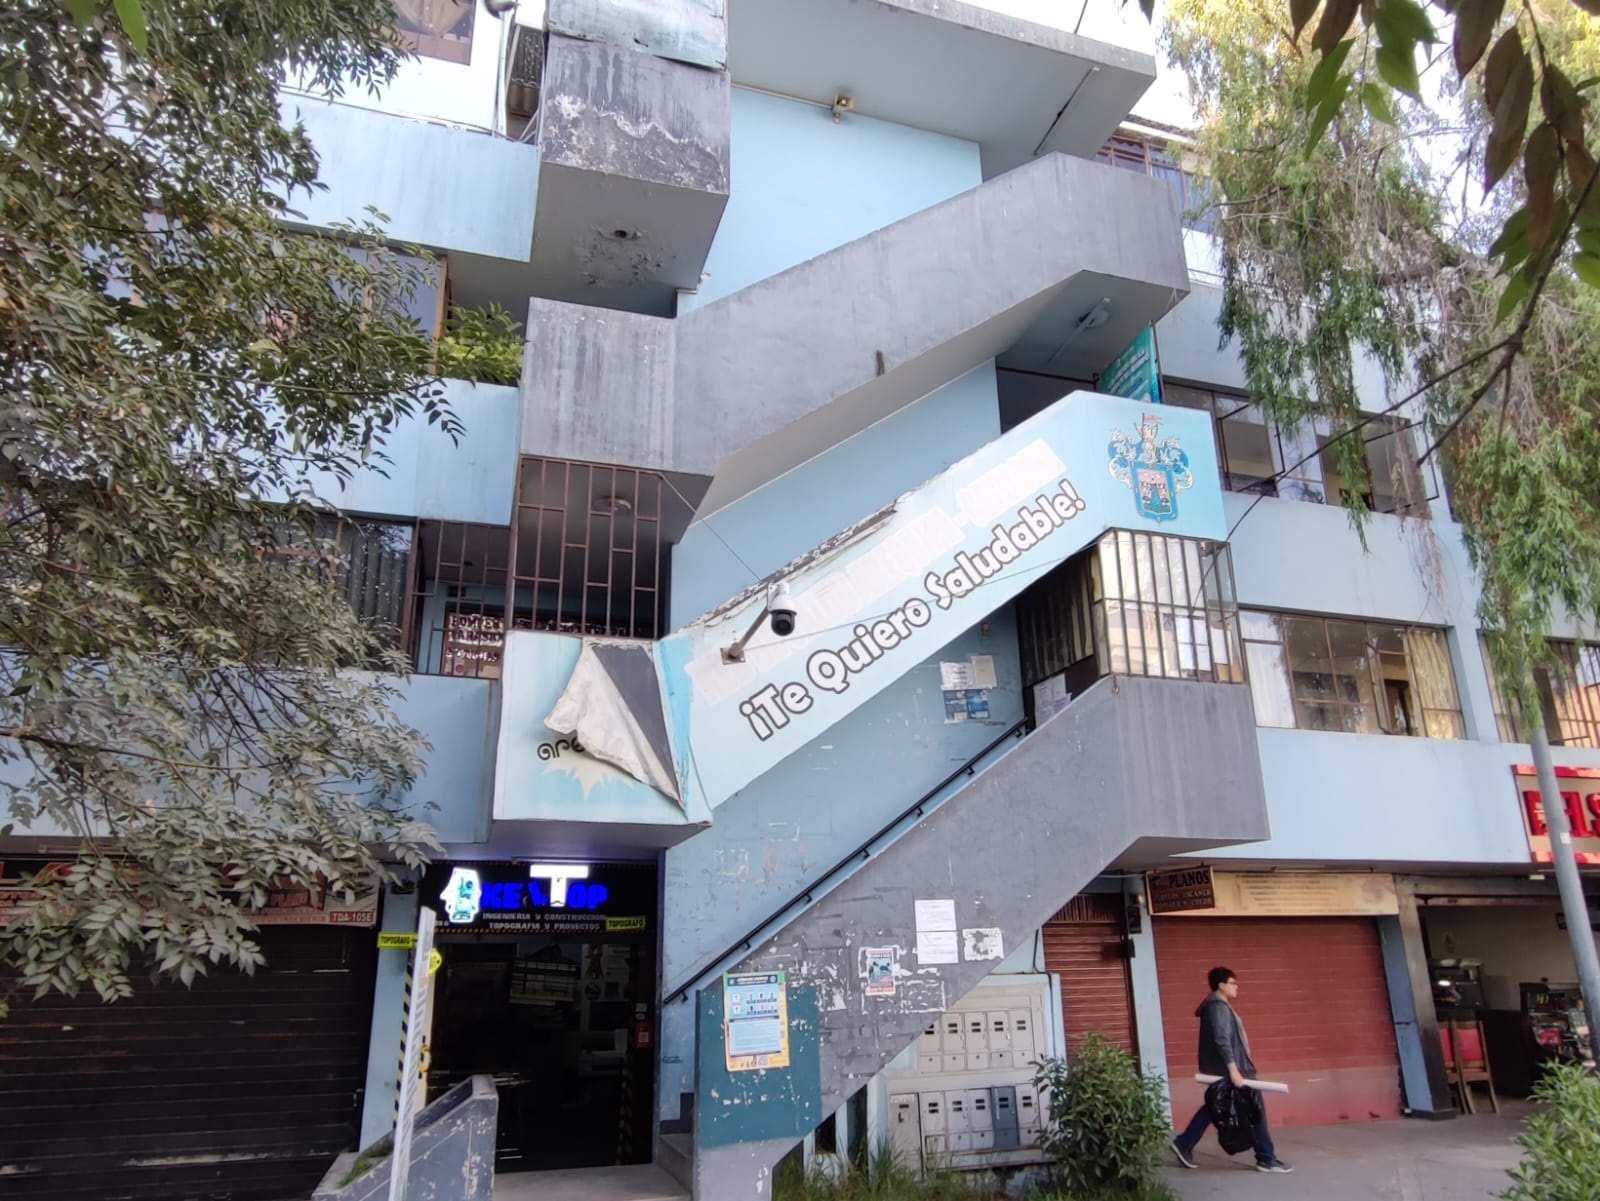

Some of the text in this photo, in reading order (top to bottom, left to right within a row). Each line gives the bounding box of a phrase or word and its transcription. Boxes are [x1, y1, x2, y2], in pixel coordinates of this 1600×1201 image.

[806, 598, 931, 693] Quiero
[924, 479, 1087, 610] Saludable!
[1168, 870, 1210, 888] PLANOS
[332, 912, 373, 922] TDA-105E
[608, 918, 645, 928] TOPOGRAFO
